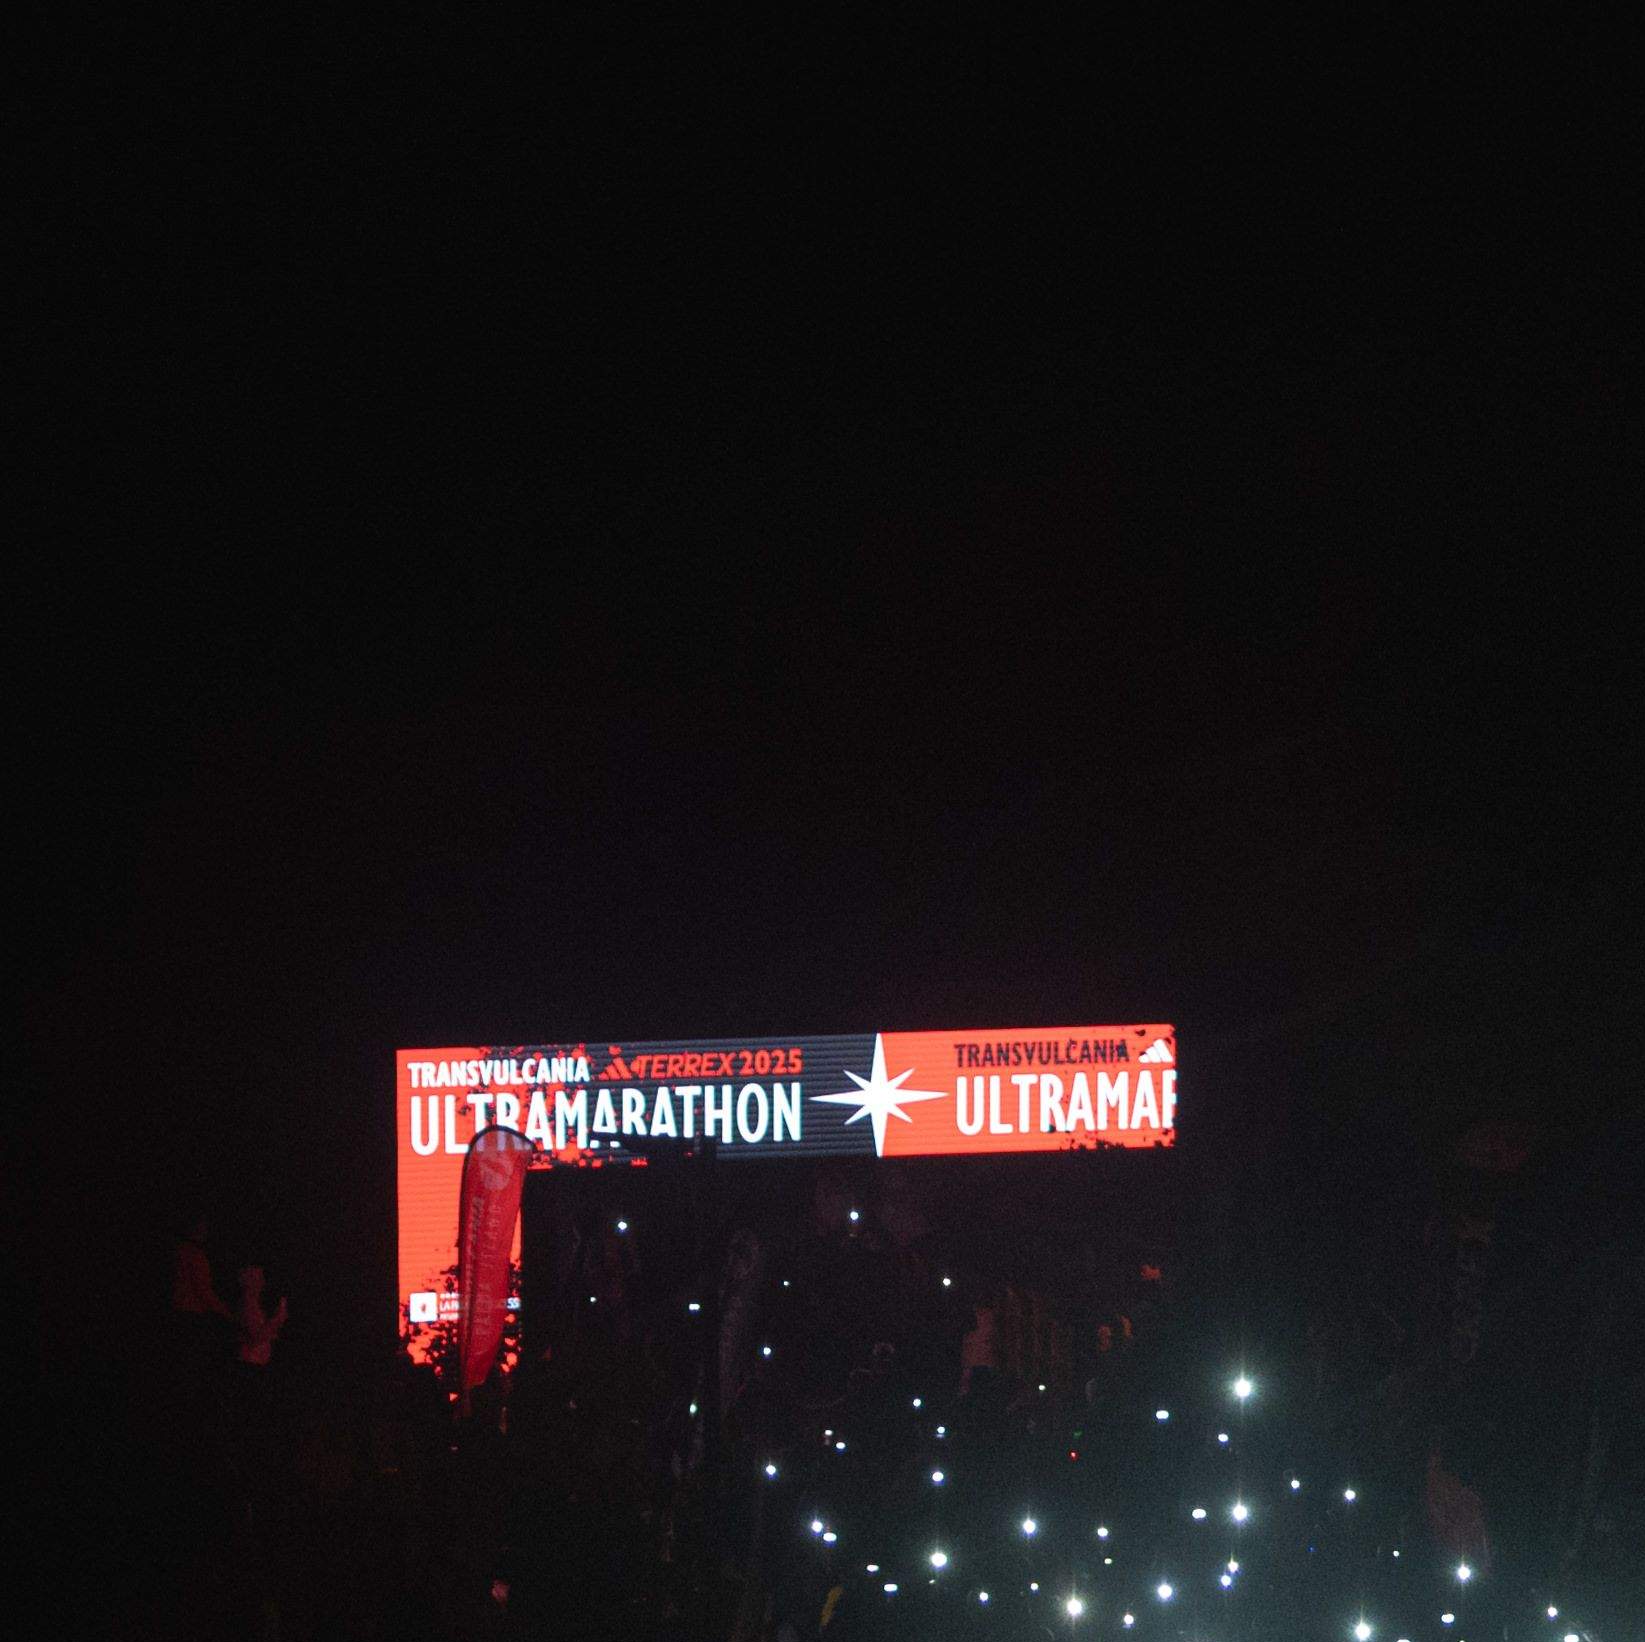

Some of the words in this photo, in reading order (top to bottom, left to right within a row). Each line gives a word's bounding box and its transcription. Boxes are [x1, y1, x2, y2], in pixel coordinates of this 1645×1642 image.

[407, 1057, 590, 1088] TRANSVULCANIA
[634, 1053, 737, 1079] TERREX
[739, 1048, 803, 1076] 2025
[954, 1039, 1131, 1068] TRANSVULCANIA
[411, 1082, 801, 1156] ULTRAMARATHON
